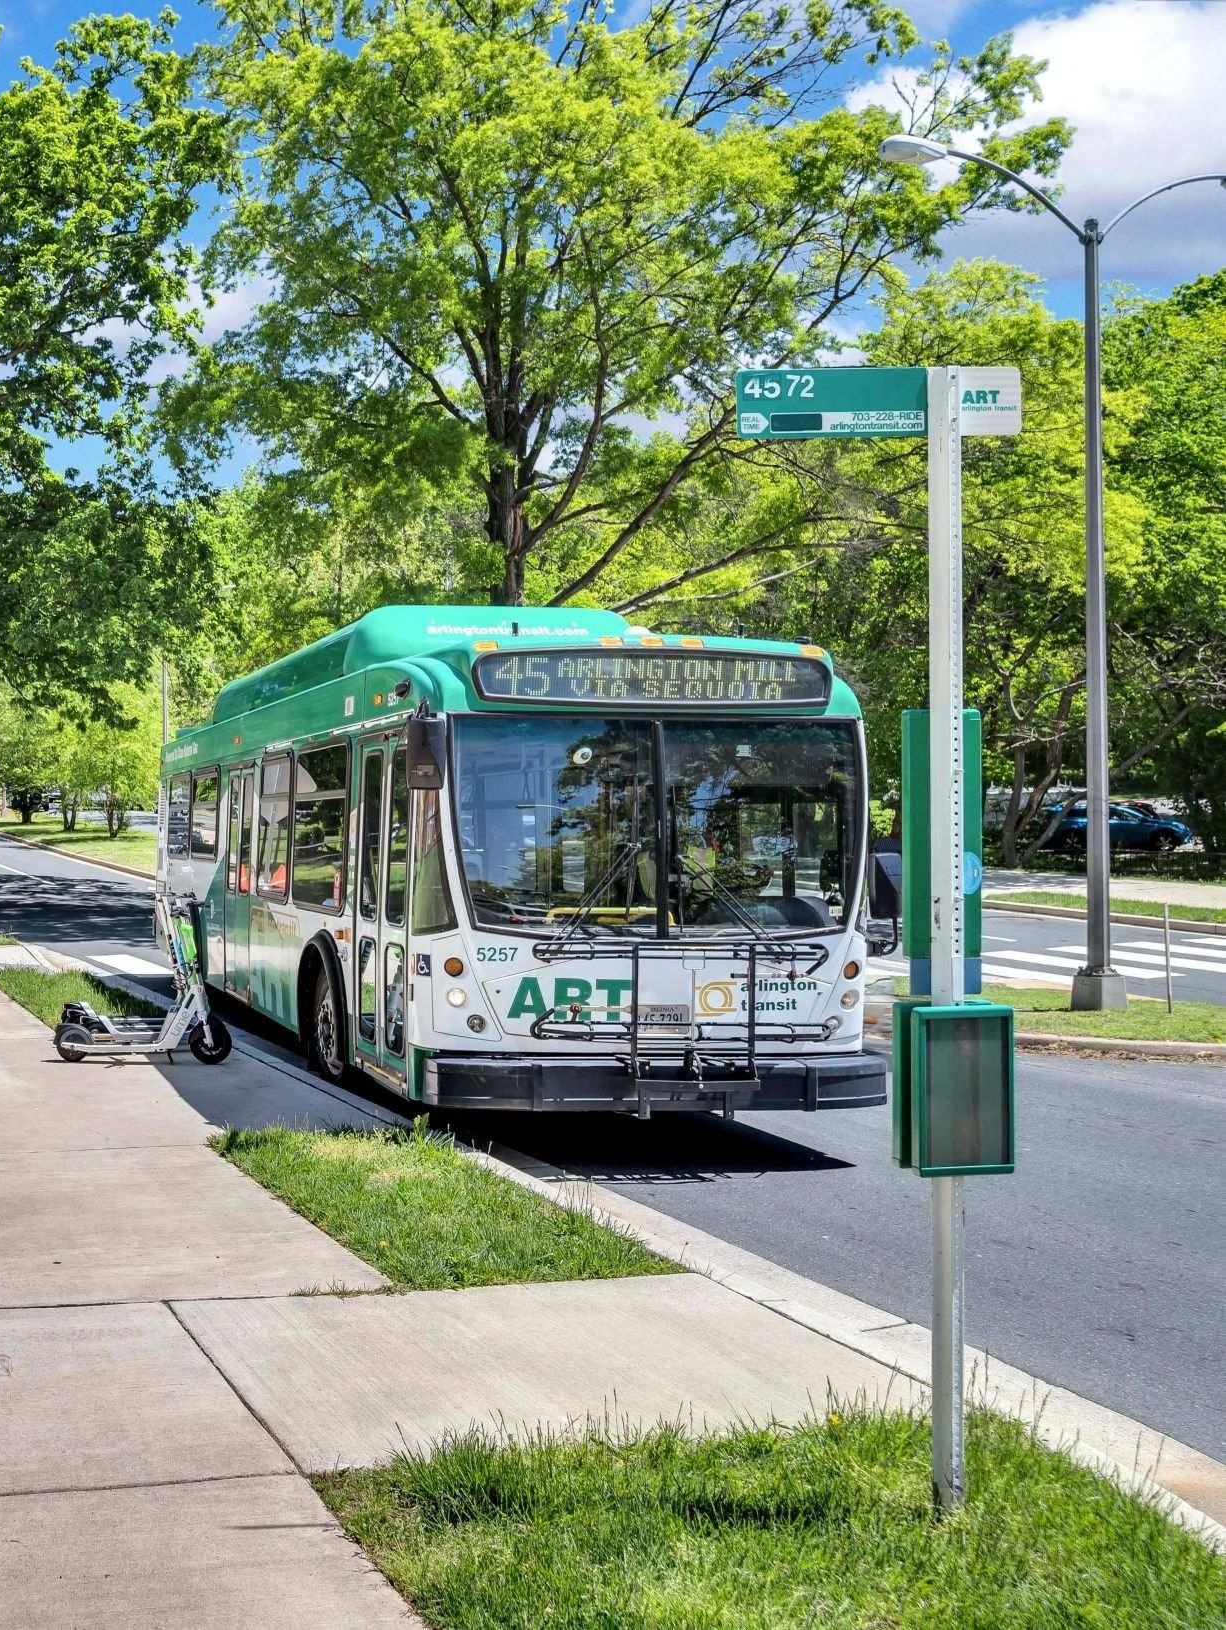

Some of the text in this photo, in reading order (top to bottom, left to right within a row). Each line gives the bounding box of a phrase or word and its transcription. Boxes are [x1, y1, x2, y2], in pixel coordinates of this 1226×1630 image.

[962, 390, 1000, 404] ART
[852, 412, 923, 421] 703-228-RIDE
[830, 421, 923, 431] arlingtontransit.com
[427, 624, 589, 636] arlingtontrnsit.com
[495, 656, 551, 696] 45
[557, 657, 796, 681] ARLINGTON MILL
[571, 679, 782, 700] VIA SEQUOIA
[477, 947, 518, 962] 5257
[740, 979, 817, 994] alington
[507, 976, 633, 1021] ART
[741, 998, 797, 1011] tansit
